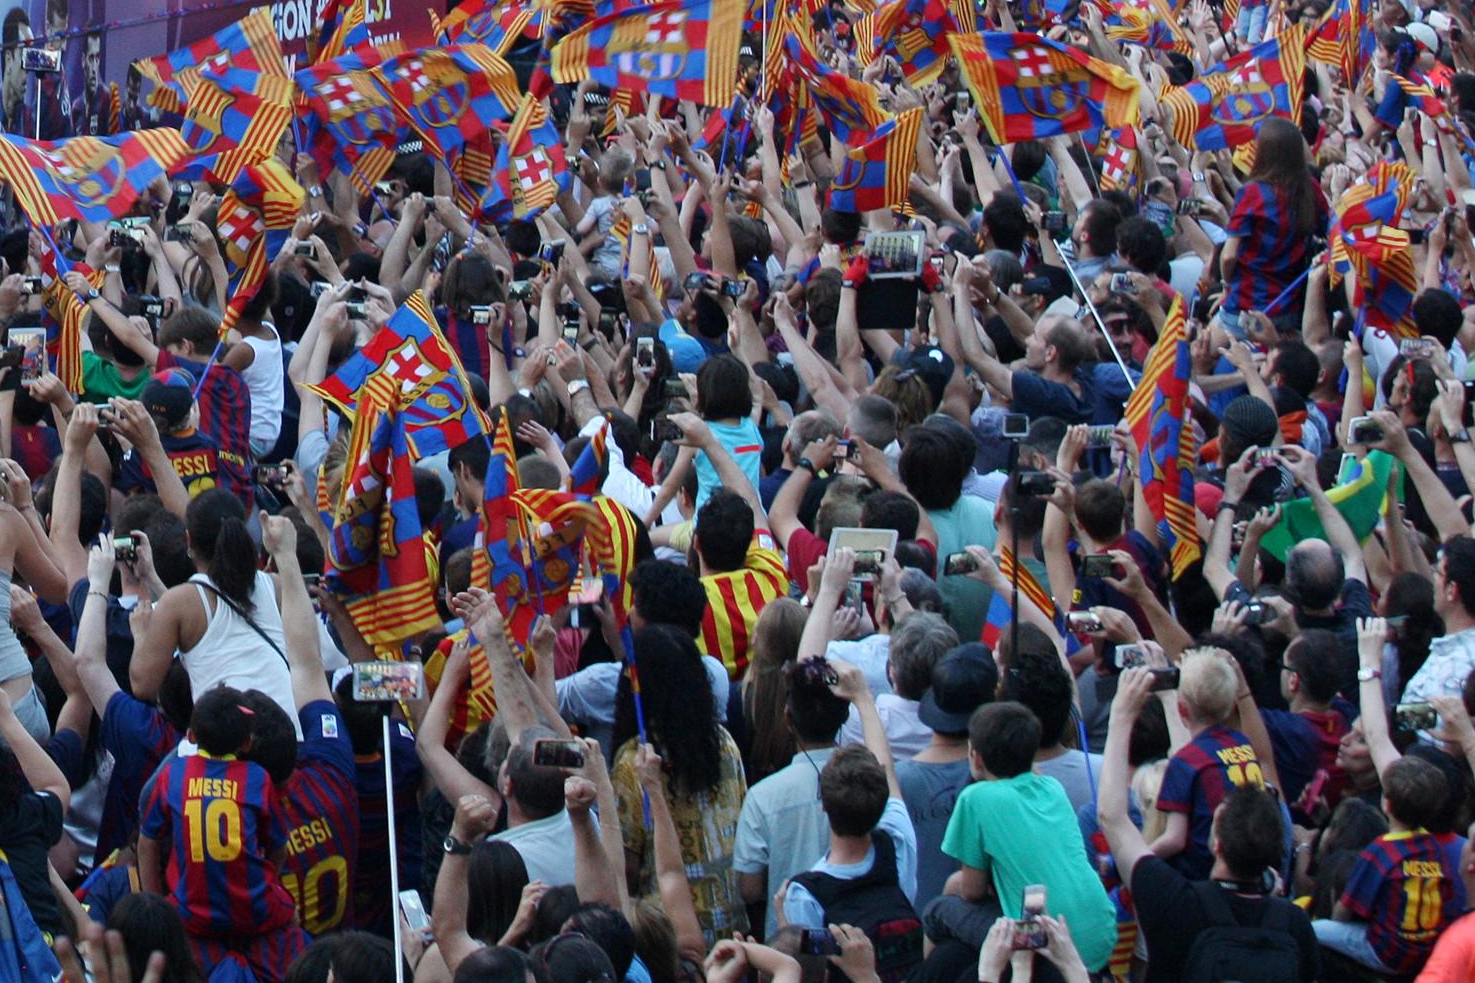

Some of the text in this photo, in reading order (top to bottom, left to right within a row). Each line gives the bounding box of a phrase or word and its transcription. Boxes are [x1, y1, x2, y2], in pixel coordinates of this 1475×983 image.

[173, 454, 211, 478] ESSI
[188, 777, 238, 800] MESSI
[184, 798, 242, 863] 10
[1402, 860, 1443, 879] MESSI
[281, 854, 348, 935] 10
[1399, 876, 1443, 932] 10
